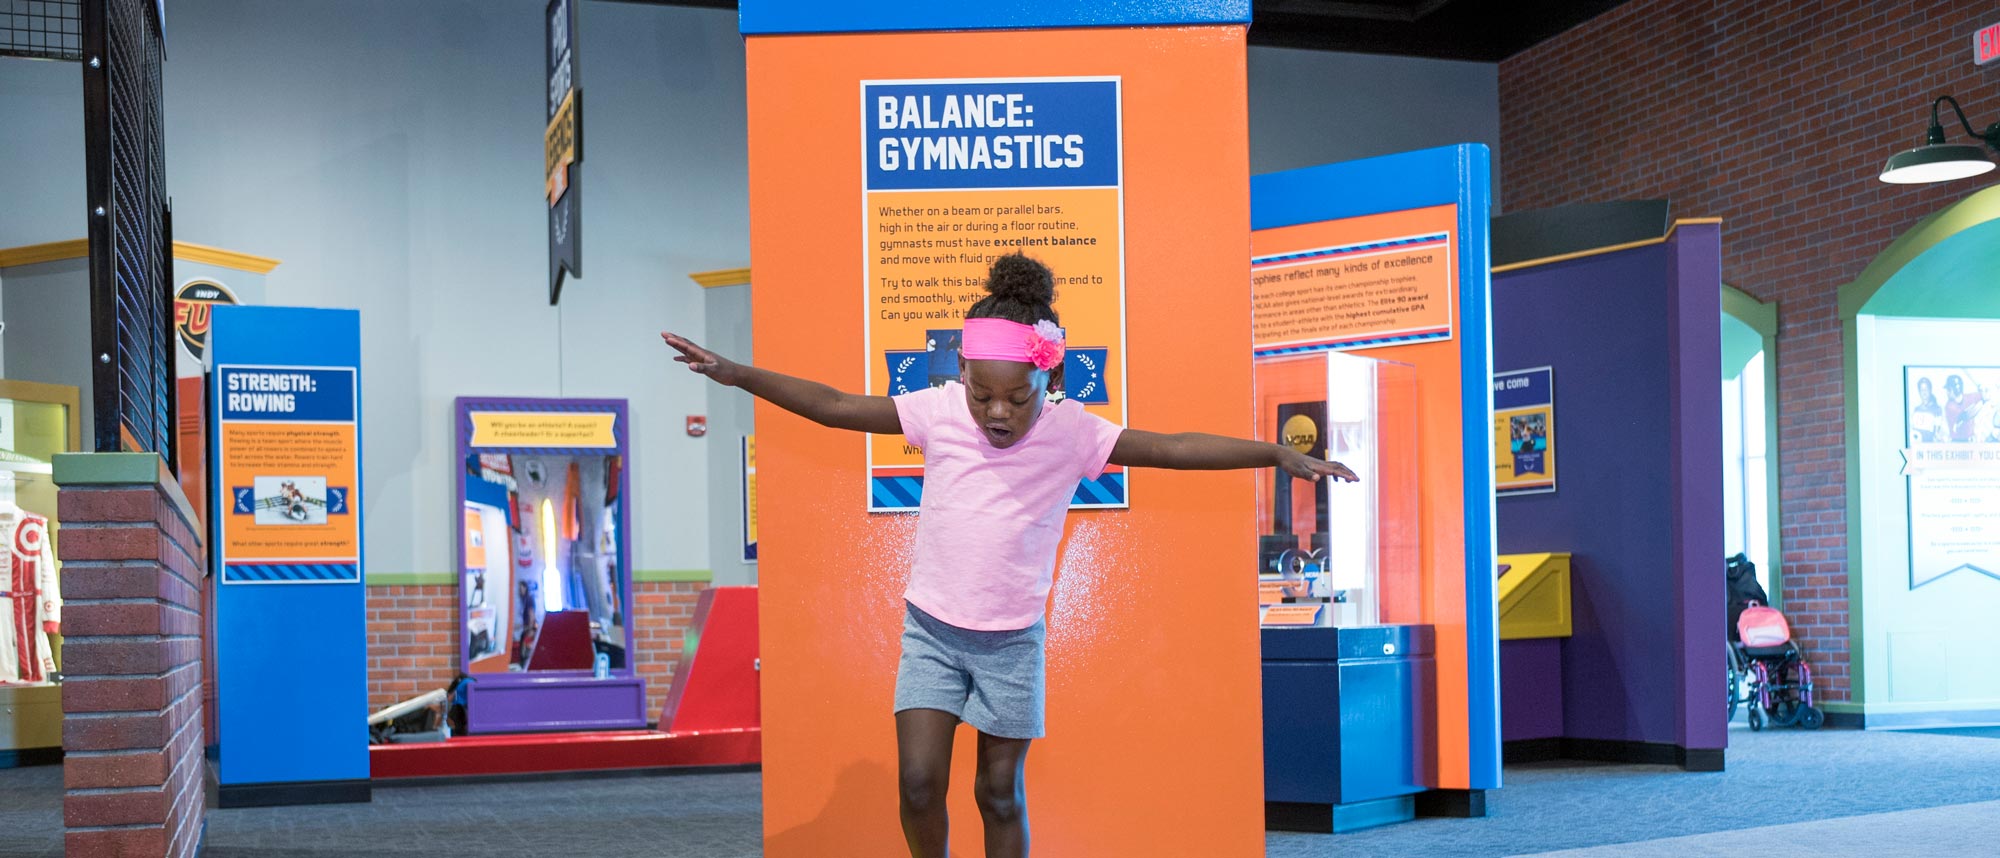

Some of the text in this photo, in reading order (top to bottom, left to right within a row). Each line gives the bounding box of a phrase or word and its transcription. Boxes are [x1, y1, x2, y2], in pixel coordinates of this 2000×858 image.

[879, 94, 1033, 130] BALANCE:
[879, 135, 1084, 171] GYMNASTICS
[879, 206, 924, 217] Whether
[927, 208, 940, 216] on
[952, 206, 980, 215] beam
[984, 207, 994, 215] or
[997, 205, 1035, 217] parallel
[879, 223, 901, 235] high
[904, 223, 913, 232] in
[917, 222, 933, 232] the
[937, 222, 949, 232] air
[953, 223, 963, 231] or
[966, 221, 998, 233] during
[1002, 223, 1008, 231] a
[1011, 221, 1035, 230] floor
[880, 236, 1097, 251] gymnasts must have excellent balance
[881, 254, 899, 264] and
[902, 255, 930, 264] move
[934, 253, 956, 263] with
[960, 253, 982, 263] fluid
[1284, 268, 1313, 281] reflect
[1317, 266, 1340, 278] many
[1344, 262, 1368, 273] kinds
[1371, 259, 1380, 271] of
[1384, 255, 1433, 268] excellence
[881, 278, 898, 290] Try
[902, 278, 912, 287] to
[915, 276, 939, 286] walk
[943, 276, 962, 286] this
[1070, 274, 1088, 285] end
[1092, 275, 1103, 284] to
[195, 290, 220, 299] INDY
[881, 293, 900, 303] end
[174, 300, 212, 335] FU
[881, 310, 900, 320] Can
[903, 311, 922, 322] you
[925, 308, 949, 319] walk
[952, 308, 960, 318] it
[228, 373, 317, 392] STRENGTH:
[1507, 378, 1529, 389] come
[228, 393, 296, 412] ROWING
[1286, 434, 1314, 446] NCAA
[1916, 450, 1924, 460] IN
[1927, 450, 1943, 460] THIS
[1978, 450, 1994, 460] YOU
